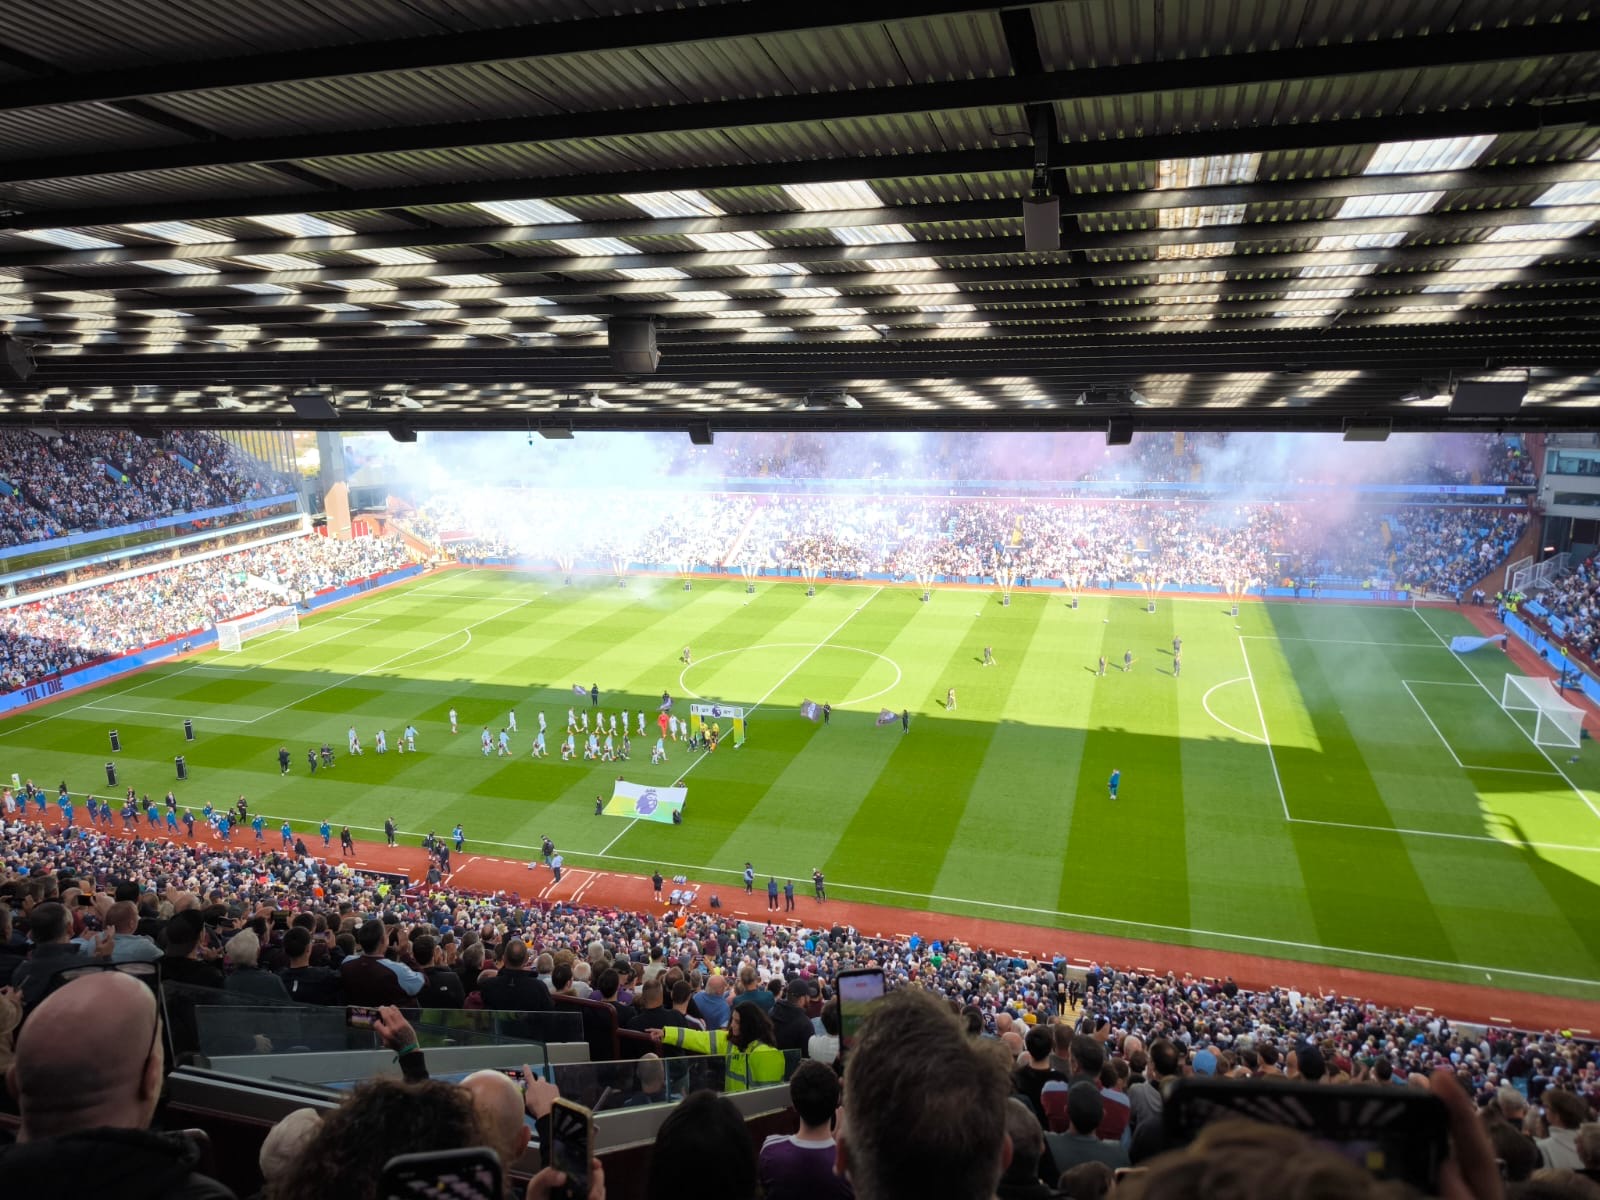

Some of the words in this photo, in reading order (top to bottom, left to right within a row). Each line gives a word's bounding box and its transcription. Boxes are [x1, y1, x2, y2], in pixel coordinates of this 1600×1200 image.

[21, 687, 40, 703] 'TIL
[41, 684, 46, 697] I
[47, 678, 64, 695] DIE
